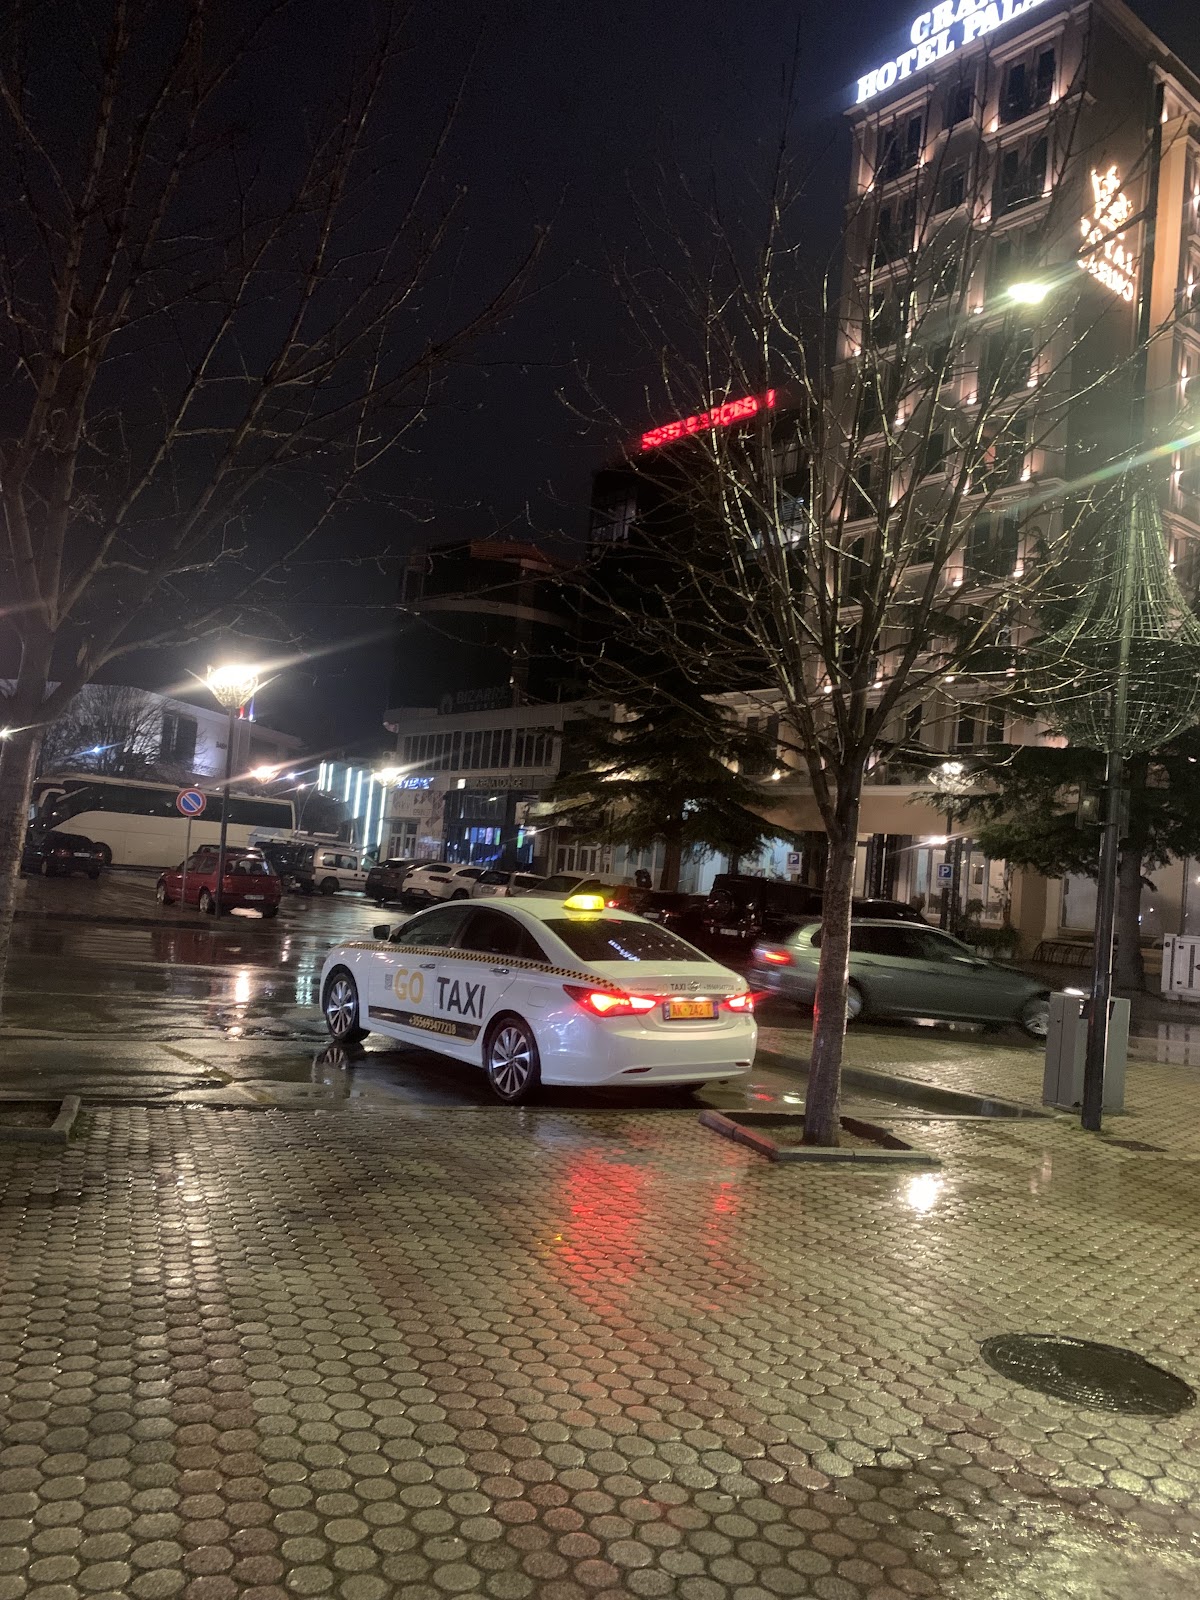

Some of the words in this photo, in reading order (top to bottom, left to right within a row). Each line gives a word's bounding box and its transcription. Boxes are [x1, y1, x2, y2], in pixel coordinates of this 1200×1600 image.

[910, 0, 998, 45] GRA
[855, 29, 955, 104] HOTEL
[789, 854, 798, 863] P
[941, 866, 950, 877] P
[394, 968, 424, 1005] GO
[437, 976, 486, 1019] TAXI
[670, 983, 686, 991] TAXI
